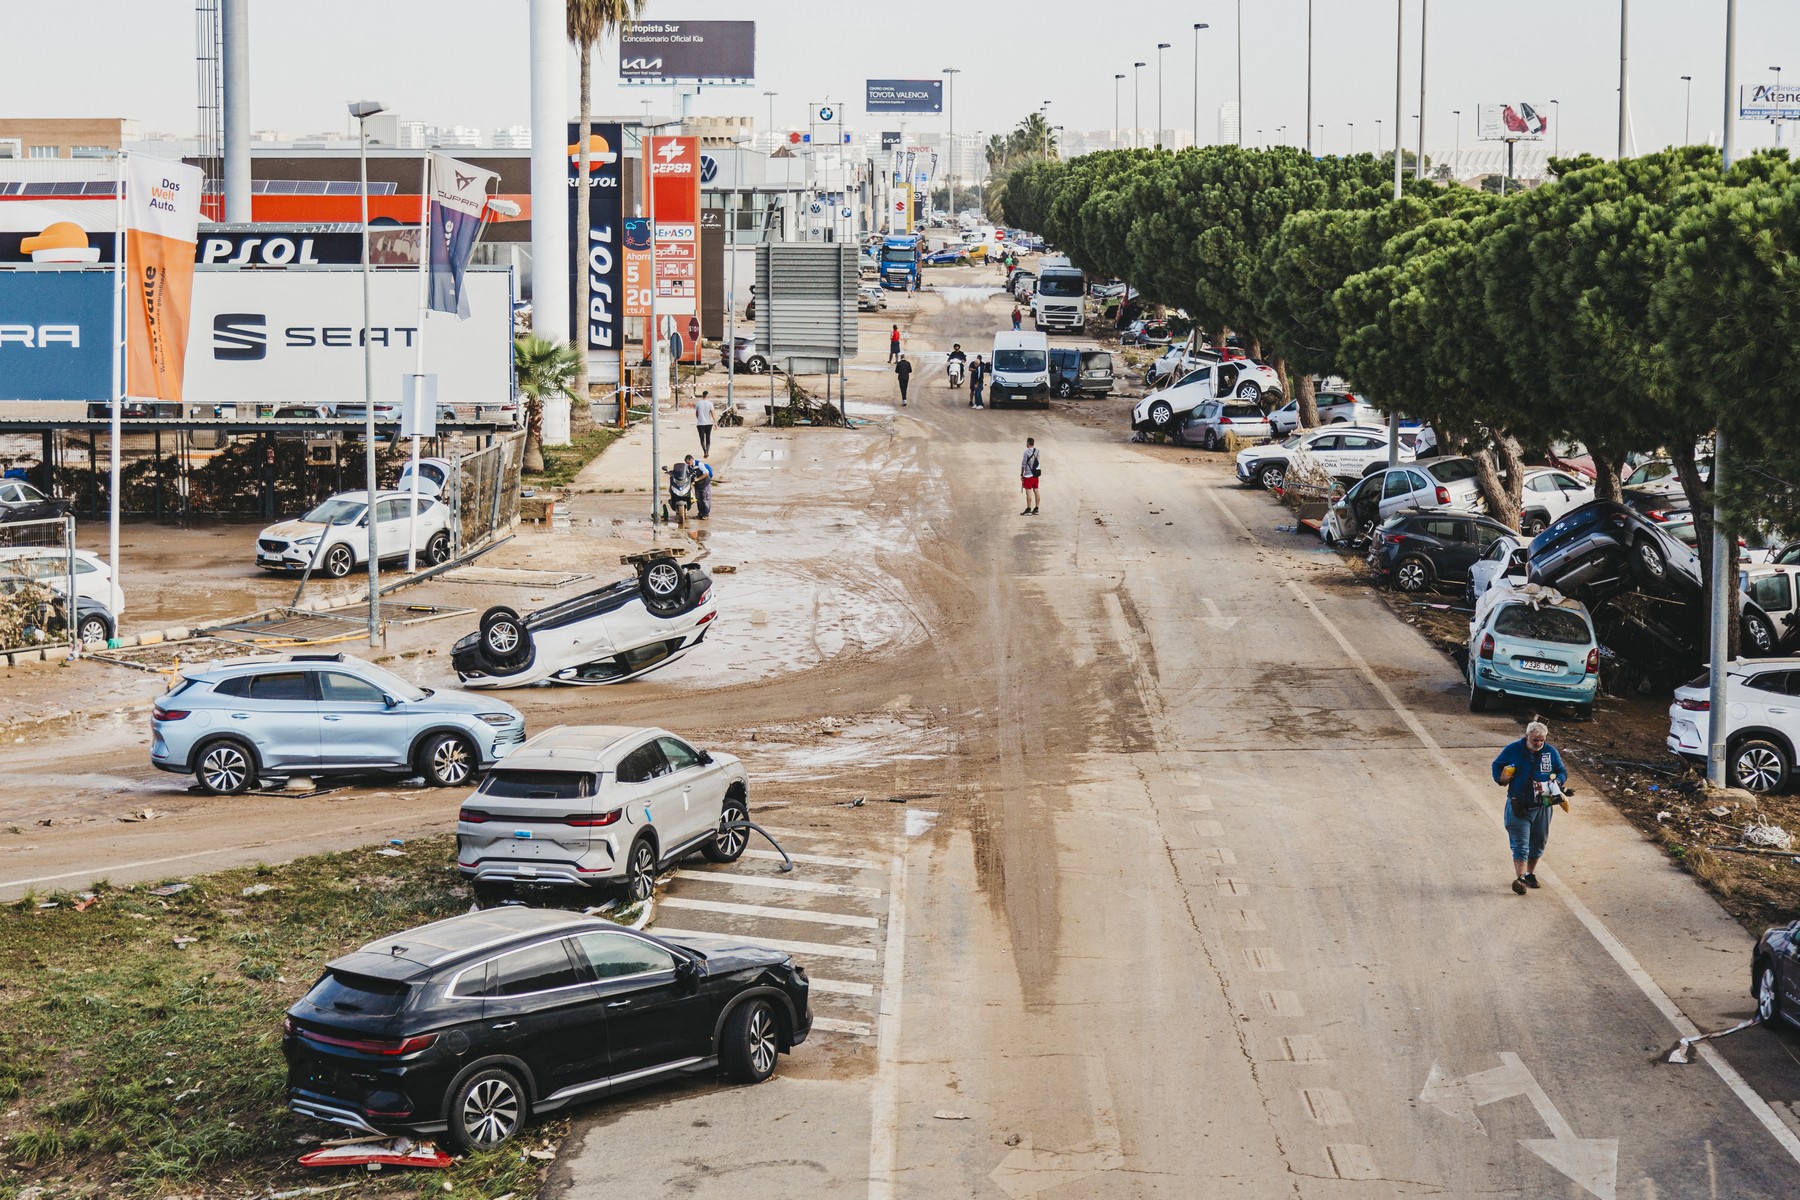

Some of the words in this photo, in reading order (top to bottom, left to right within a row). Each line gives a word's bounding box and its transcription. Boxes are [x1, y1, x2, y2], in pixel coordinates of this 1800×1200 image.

[622, 24, 663, 34] Autopista
[665, 24, 679, 33] Sur
[622, 35, 669, 43] Concesionario
[670, 35, 692, 43] Oficial
[692, 35, 704, 43] Kia
[622, 58, 662, 69] KIA
[869, 91, 895, 99] TOYOTA
[896, 91, 929, 99] VALENCIA
[652, 163, 692, 174] CEPSA
[161, 178, 180, 192] Das
[151, 186, 175, 202] Welt
[437, 190, 479, 210] CUPRA
[149, 198, 176, 213] Auto.
[195, 237, 319, 264] PSOL
[626, 265, 640, 283] 5
[626, 288, 652, 306] 20
[285, 327, 418, 347] SEAT
